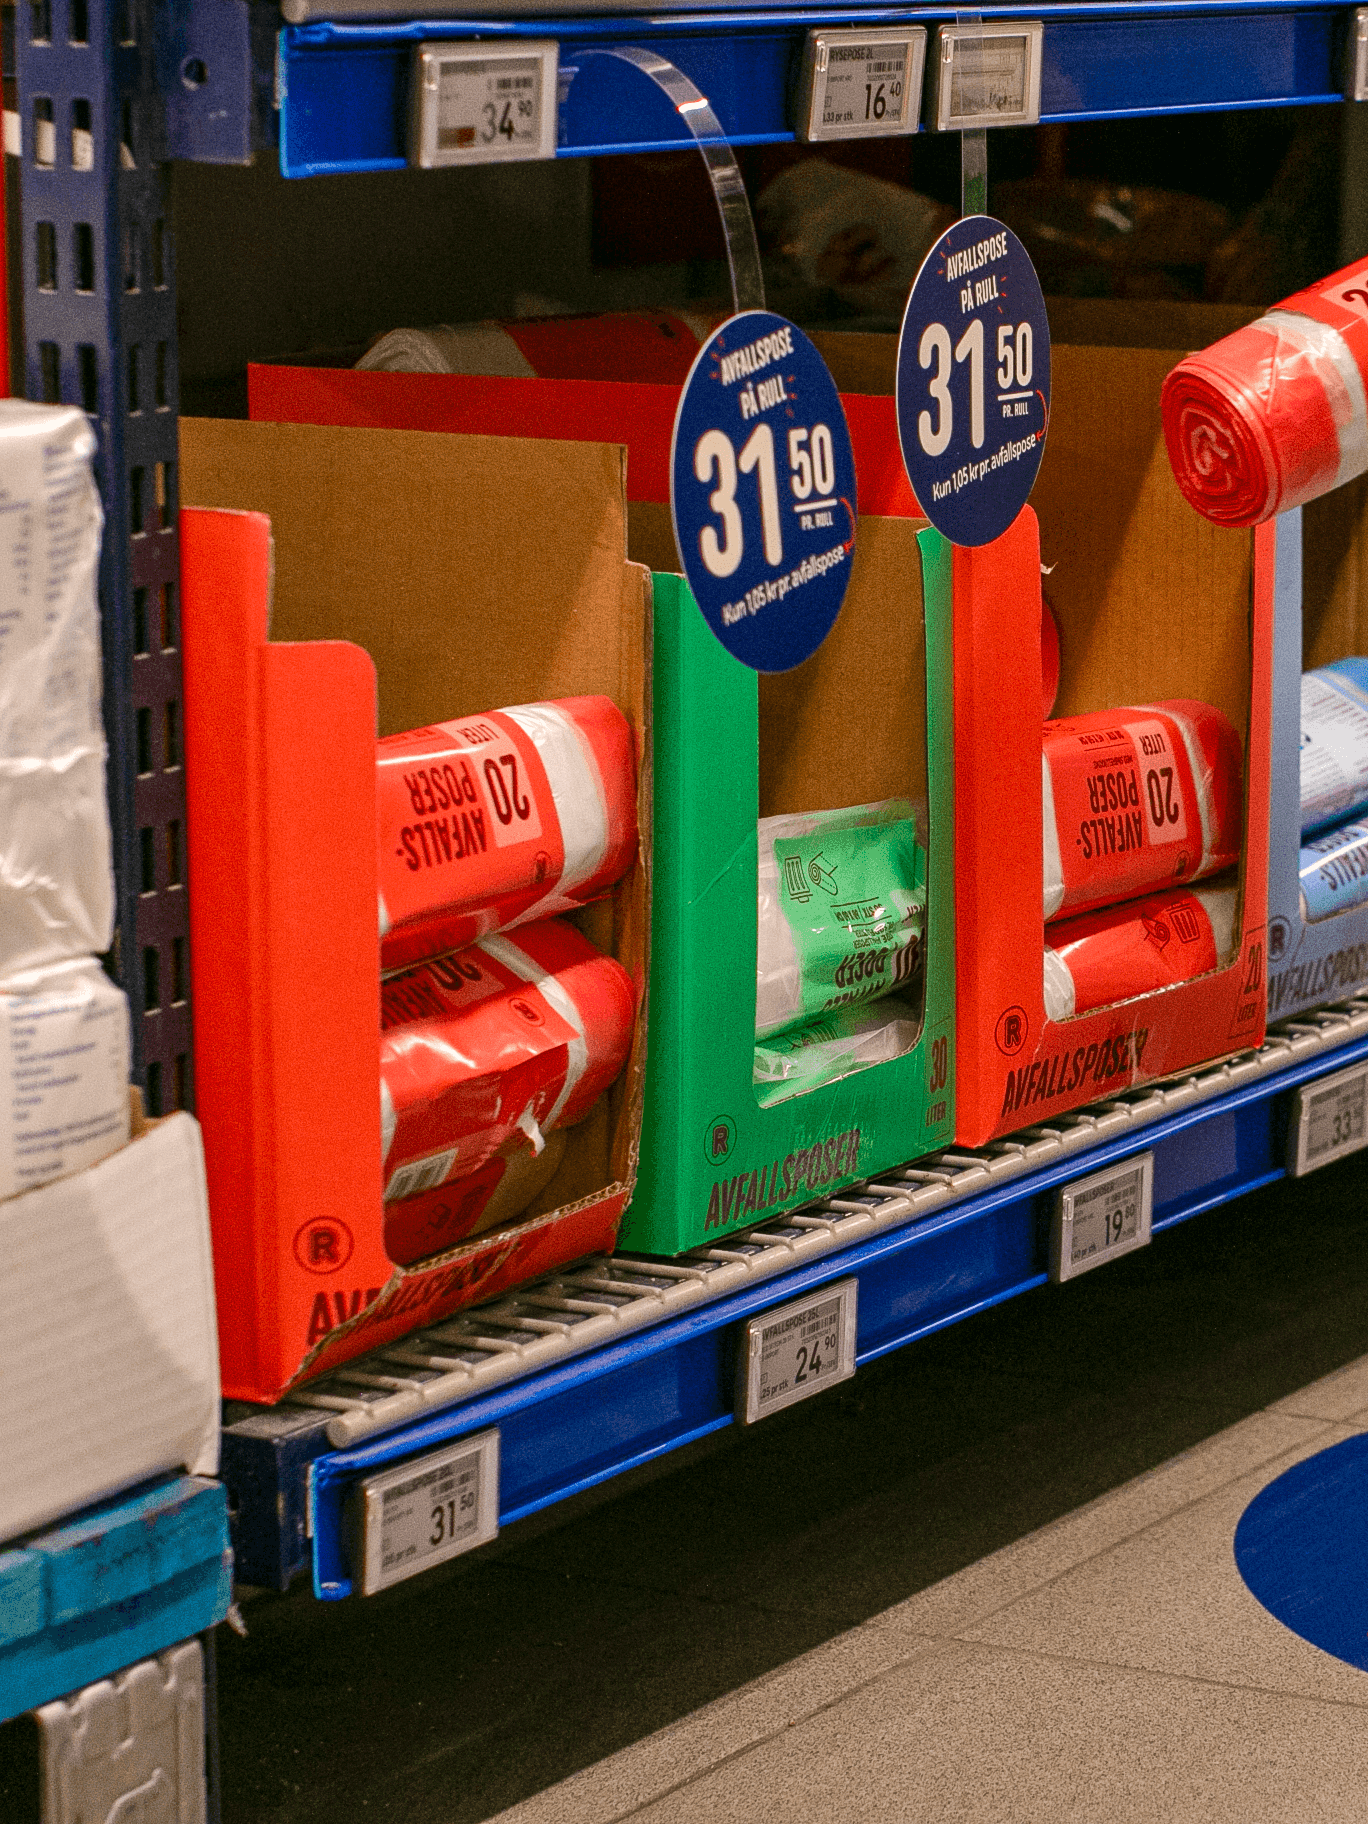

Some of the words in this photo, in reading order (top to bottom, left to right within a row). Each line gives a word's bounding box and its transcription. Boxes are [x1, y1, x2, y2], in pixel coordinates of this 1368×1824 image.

[481, 101, 514, 143] 34
[865, 83, 887, 120] 16
[890, 81, 901, 97] 40
[947, 231, 1008, 282] AVFALLSPOSE
[960, 281, 975, 314] PÅ
[976, 274, 999, 304] RULL
[719, 325, 794, 386] AVFALLSPOSE
[739, 381, 758, 420] PÅ
[758, 374, 788, 412] RULL
[918, 318, 985, 457] 31
[997, 322, 1033, 389] 50
[1003, 404, 1014, 418] PR.
[1014, 402, 1029, 416] RULL
[932, 481, 951, 502] Kun
[952, 471, 969, 496] 1,05
[969, 462, 980, 482] kr
[980, 462, 991, 479] pr.
[991, 433, 1036, 470] avfallspose
[695, 423, 783, 578] 31
[788, 423, 835, 499] 50
[816, 510, 833, 528] RULL
[721, 601, 747, 627] Kun
[791, 544, 846, 588] avfallspose
[457, 723, 500, 745] LITER
[1139, 733, 1166, 756] LITER
[403, 761, 478, 816] POSER
[484, 754, 530, 826] 20
[1086, 769, 1140, 814] POSER
[1146, 766, 1180, 827] 20
[1244, 942, 1262, 995] 20
[929, 1035, 947, 1094] 30
[1002, 1028, 1148, 1117] AVFALLSPOSER
[926, 1101, 946, 1127] LITER
[1332, 1111, 1351, 1146] 33
[704, 1129, 860, 1231] AVFALLSPOSER
[1105, 1209, 1123, 1246] 19
[795, 1341, 821, 1384] 24
[825, 1334, 836, 1350] 90
[430, 1501, 455, 1545] 31
